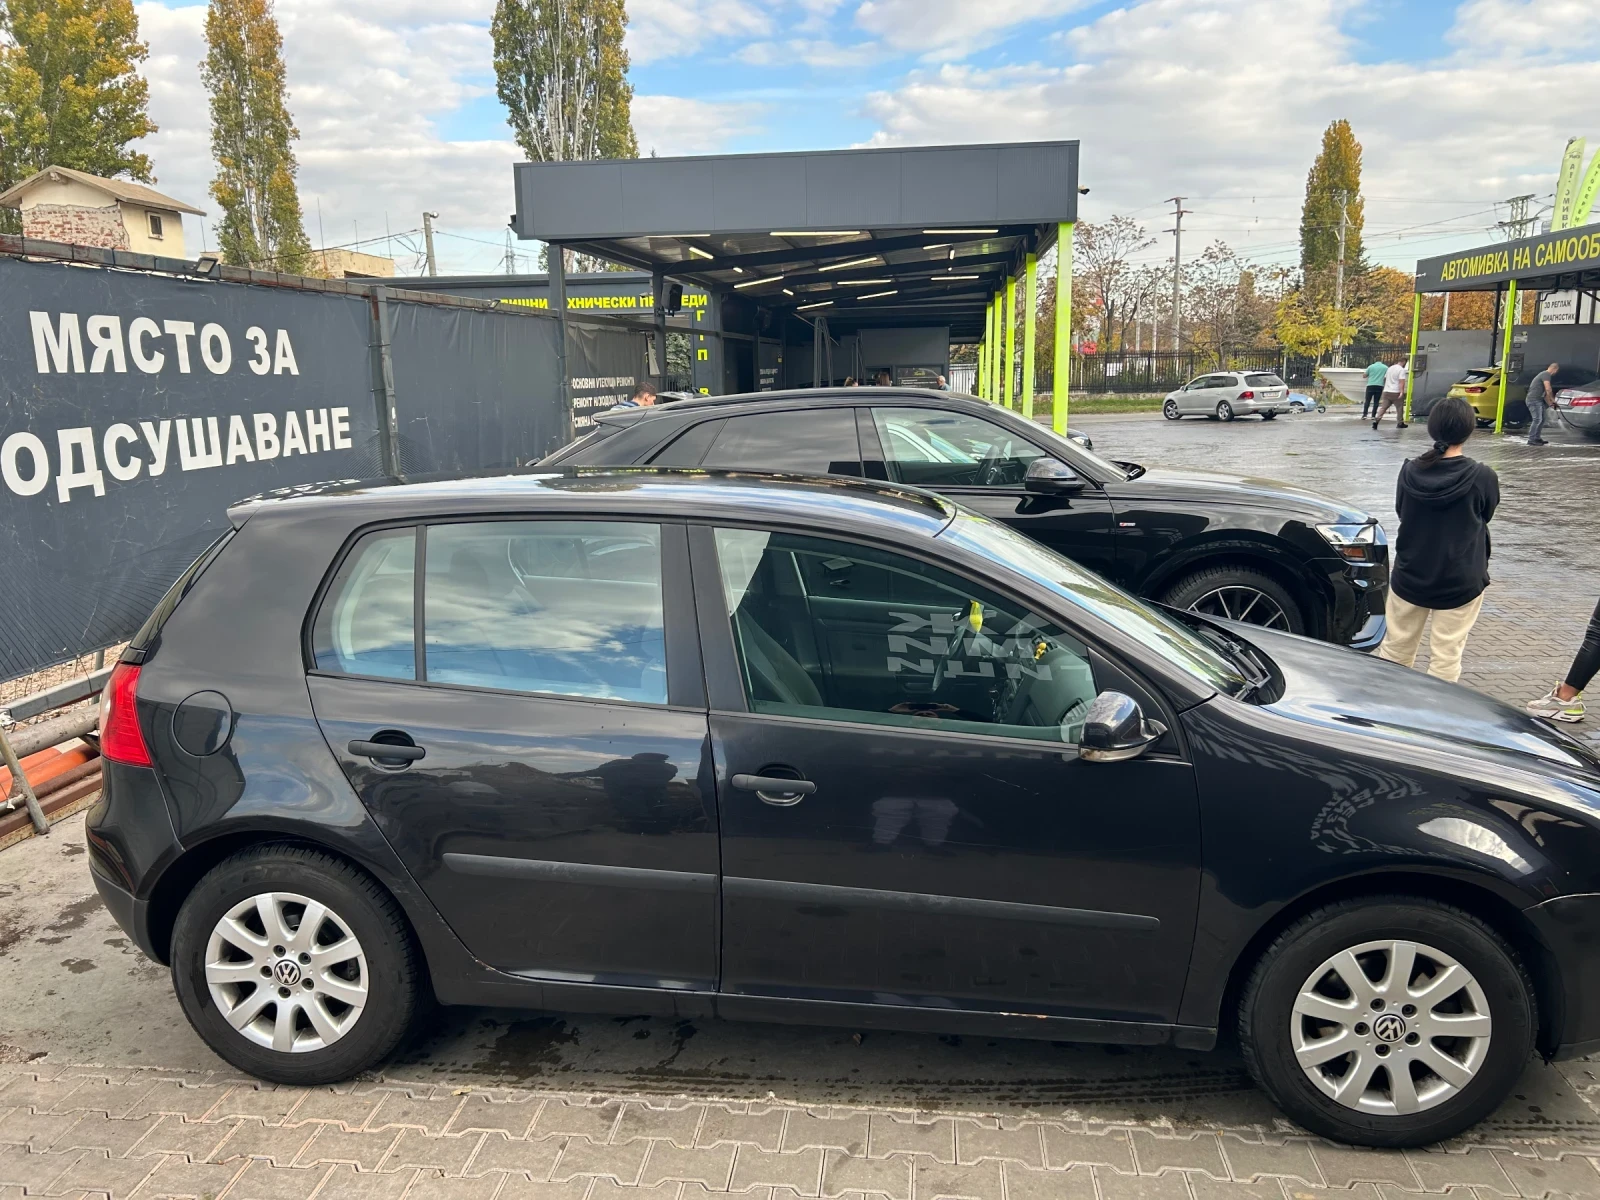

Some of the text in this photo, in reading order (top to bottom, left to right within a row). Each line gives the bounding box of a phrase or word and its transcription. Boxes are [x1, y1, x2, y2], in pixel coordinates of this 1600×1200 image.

[1440, 232, 1600, 281] АВТОМИВКА НА САМООБ
[567, 295, 636, 309] ХНИЧЕСКИ
[29, 311, 300, 376] МЯСТО ЗА
[0, 407, 352, 503] ОДСУШАВАНЕ
